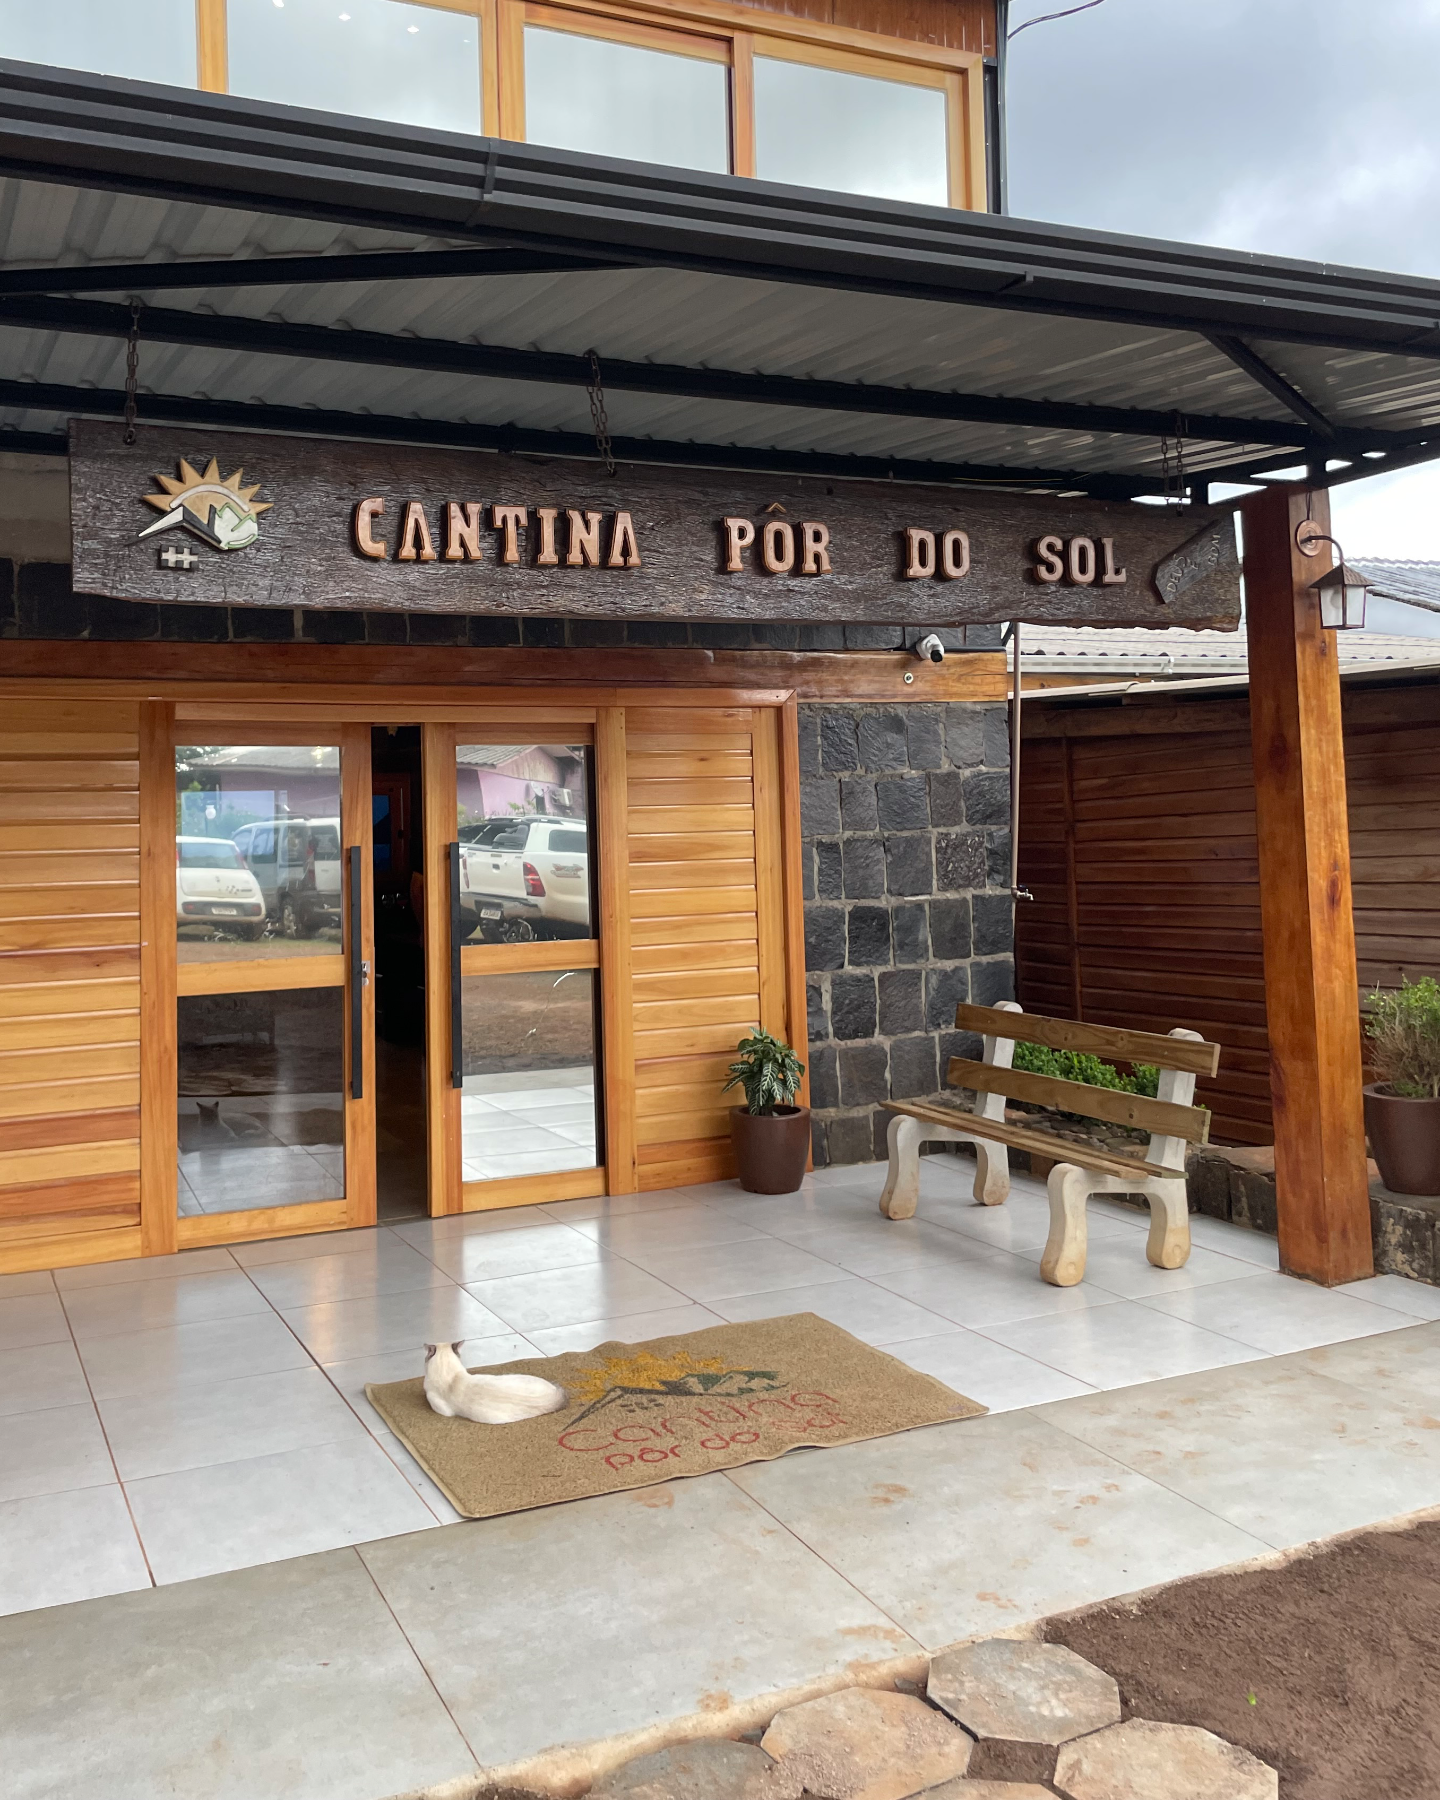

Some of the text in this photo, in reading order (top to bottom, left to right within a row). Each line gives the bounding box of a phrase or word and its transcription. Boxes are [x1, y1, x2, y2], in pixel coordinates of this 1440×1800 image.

[354, 497, 1127, 584] CANTINA PÔR DO SOL
[1166, 554, 1187, 592] DEUS
[1208, 534, 1221, 566] BOM
[700, 1431, 760, 1450] do
